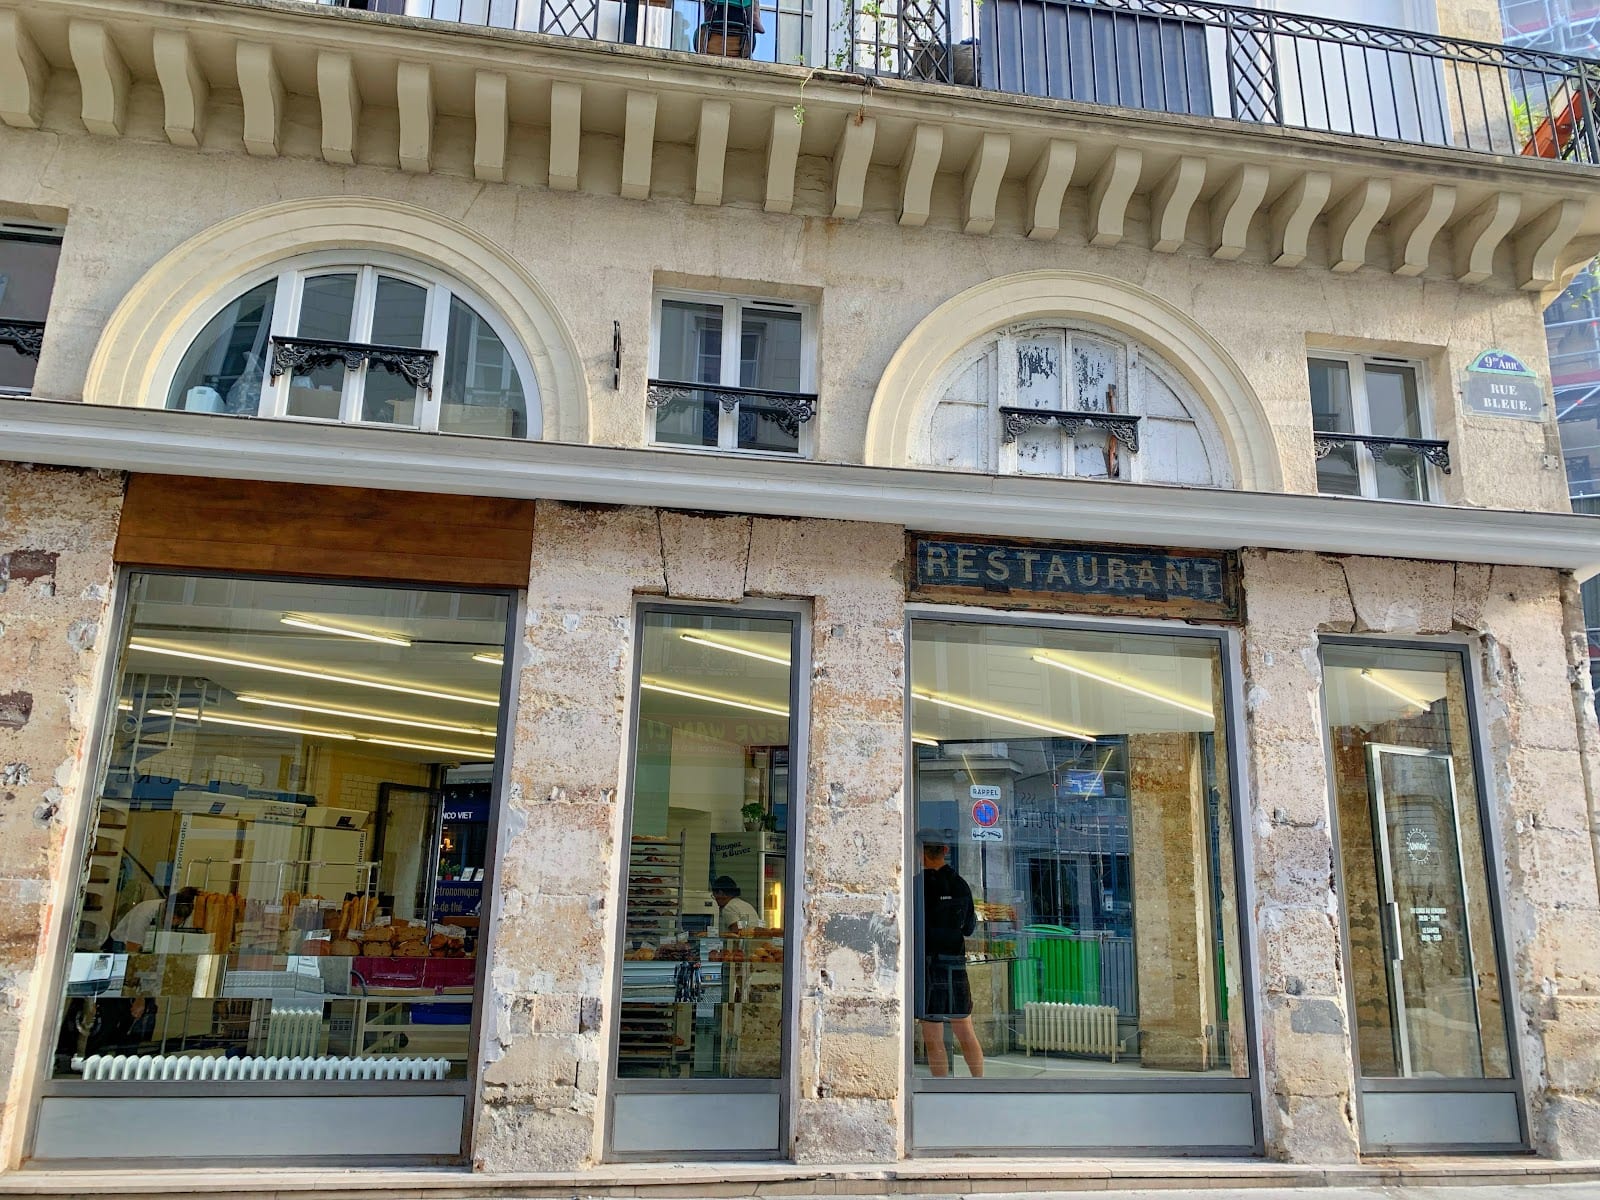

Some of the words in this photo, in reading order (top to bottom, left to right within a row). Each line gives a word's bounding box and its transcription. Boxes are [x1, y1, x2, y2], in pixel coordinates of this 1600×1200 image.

[1490, 383, 1518, 395] RUE
[1483, 398, 1532, 411] BLEUE.
[926, 546, 1218, 597] RESTAURANT
[972, 788, 998, 796] RAPPEL
[458, 811, 473, 820] VIET
[176, 820, 188, 869] panimatic
[1409, 842, 1428, 851] UNION
[440, 901, 449, 912] de
[450, 900, 463, 912] thé
